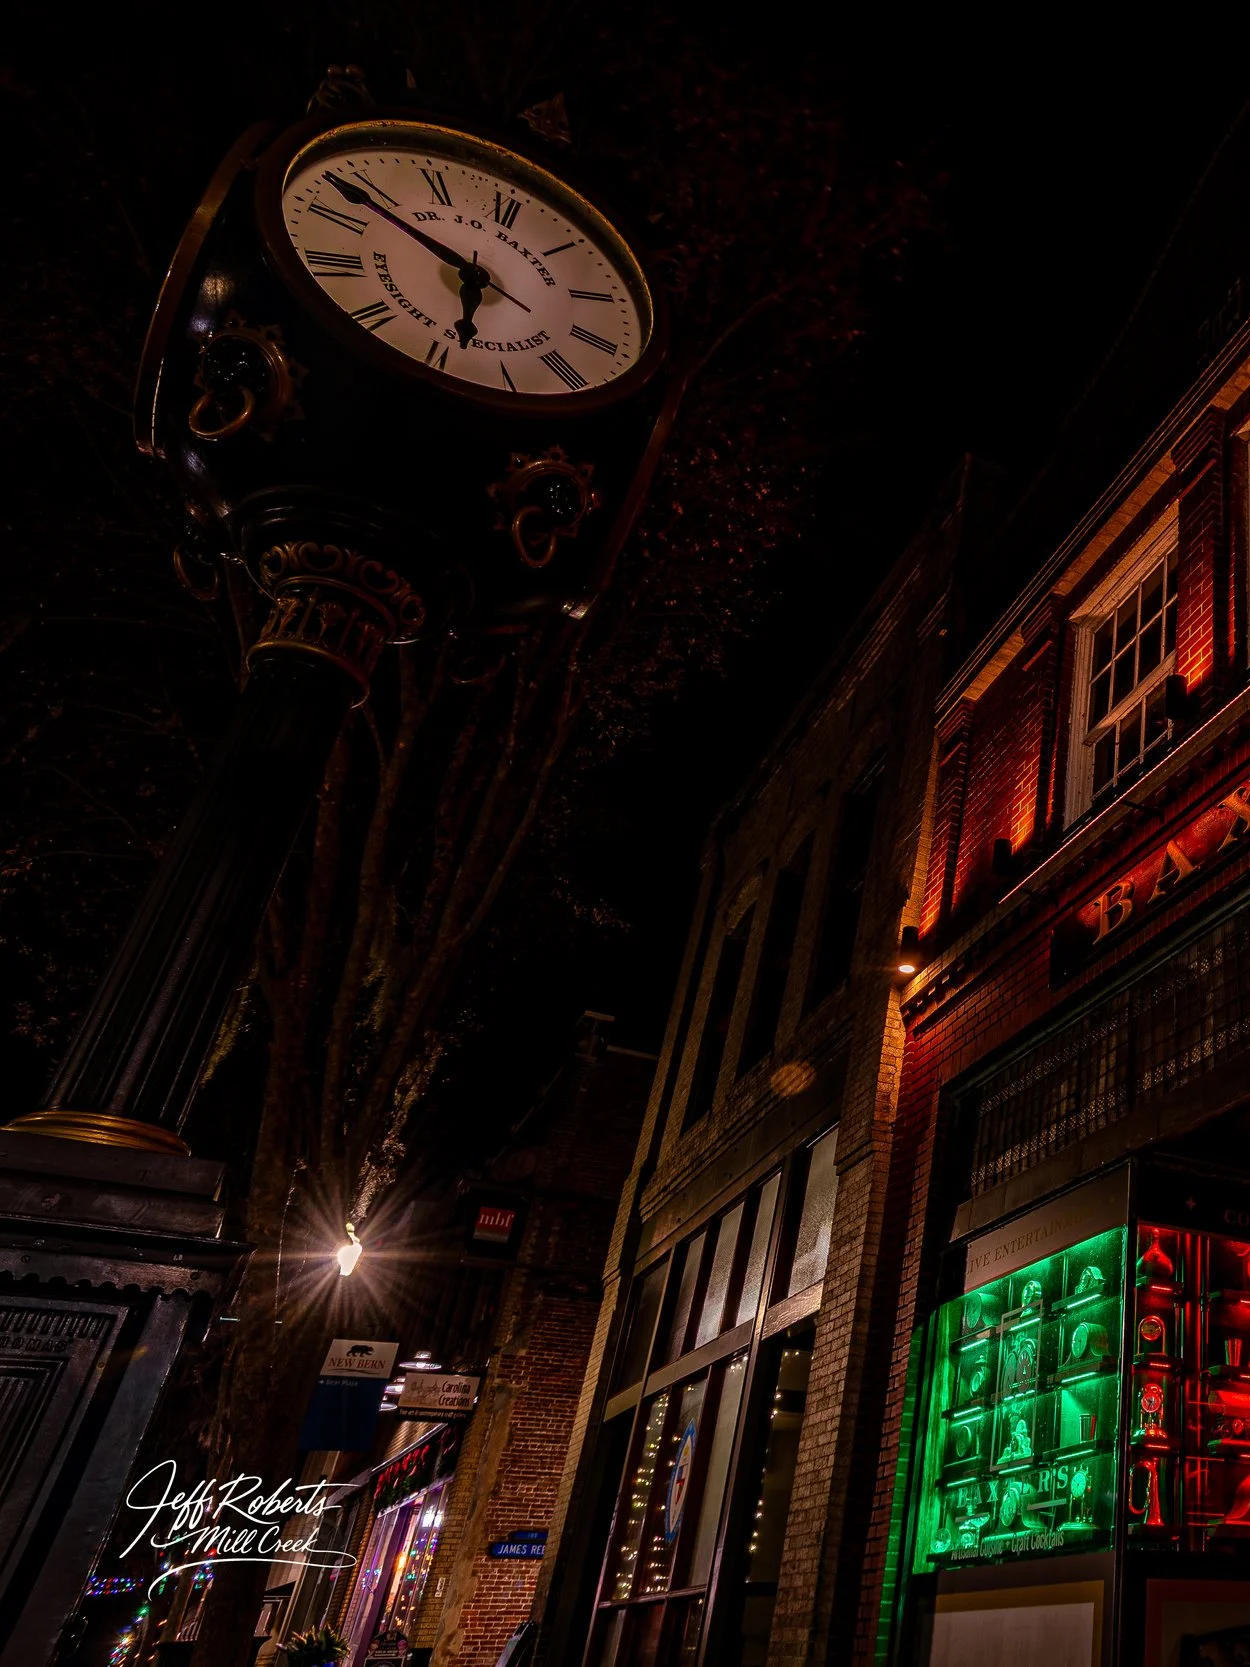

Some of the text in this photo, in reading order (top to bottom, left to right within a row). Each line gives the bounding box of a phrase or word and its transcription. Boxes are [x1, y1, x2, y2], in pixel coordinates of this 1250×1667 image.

[411, 211, 556, 287] DR. J.O. BAXTER
[373, 251, 551, 352] EYESIGHT SECIALIST
[328, 1357, 387, 1369] NEW BERN
[442, 1381, 471, 1394] Carolina
[438, 1394, 470, 1407] Creations
[497, 1544, 528, 1555] JAMES
